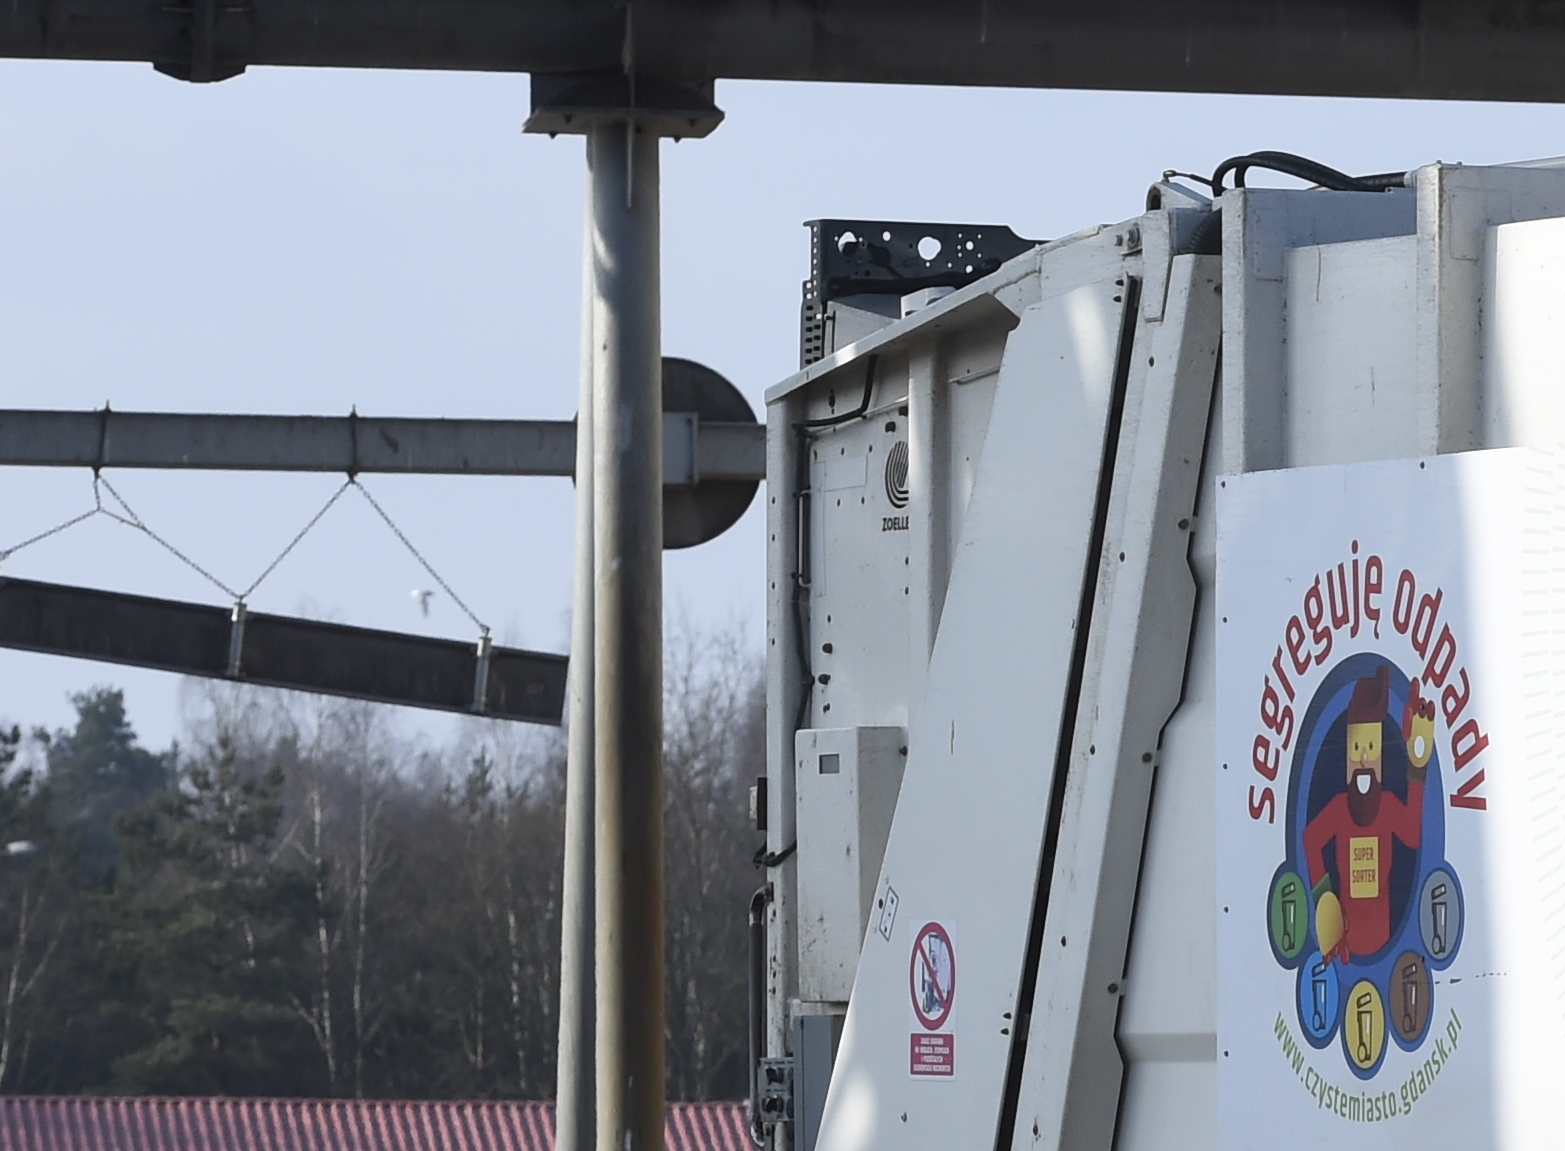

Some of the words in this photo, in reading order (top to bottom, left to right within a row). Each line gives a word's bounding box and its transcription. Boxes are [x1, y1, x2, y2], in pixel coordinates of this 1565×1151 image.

[1248, 539, 1383, 824] segreguję
[1393, 569, 1490, 811] odpady
[1352, 868, 1375, 883] SORTER
[1353, 846, 1374, 861] SUPER
[1273, 1007, 1462, 1123] www.czystemiasto.gdansk.pl
